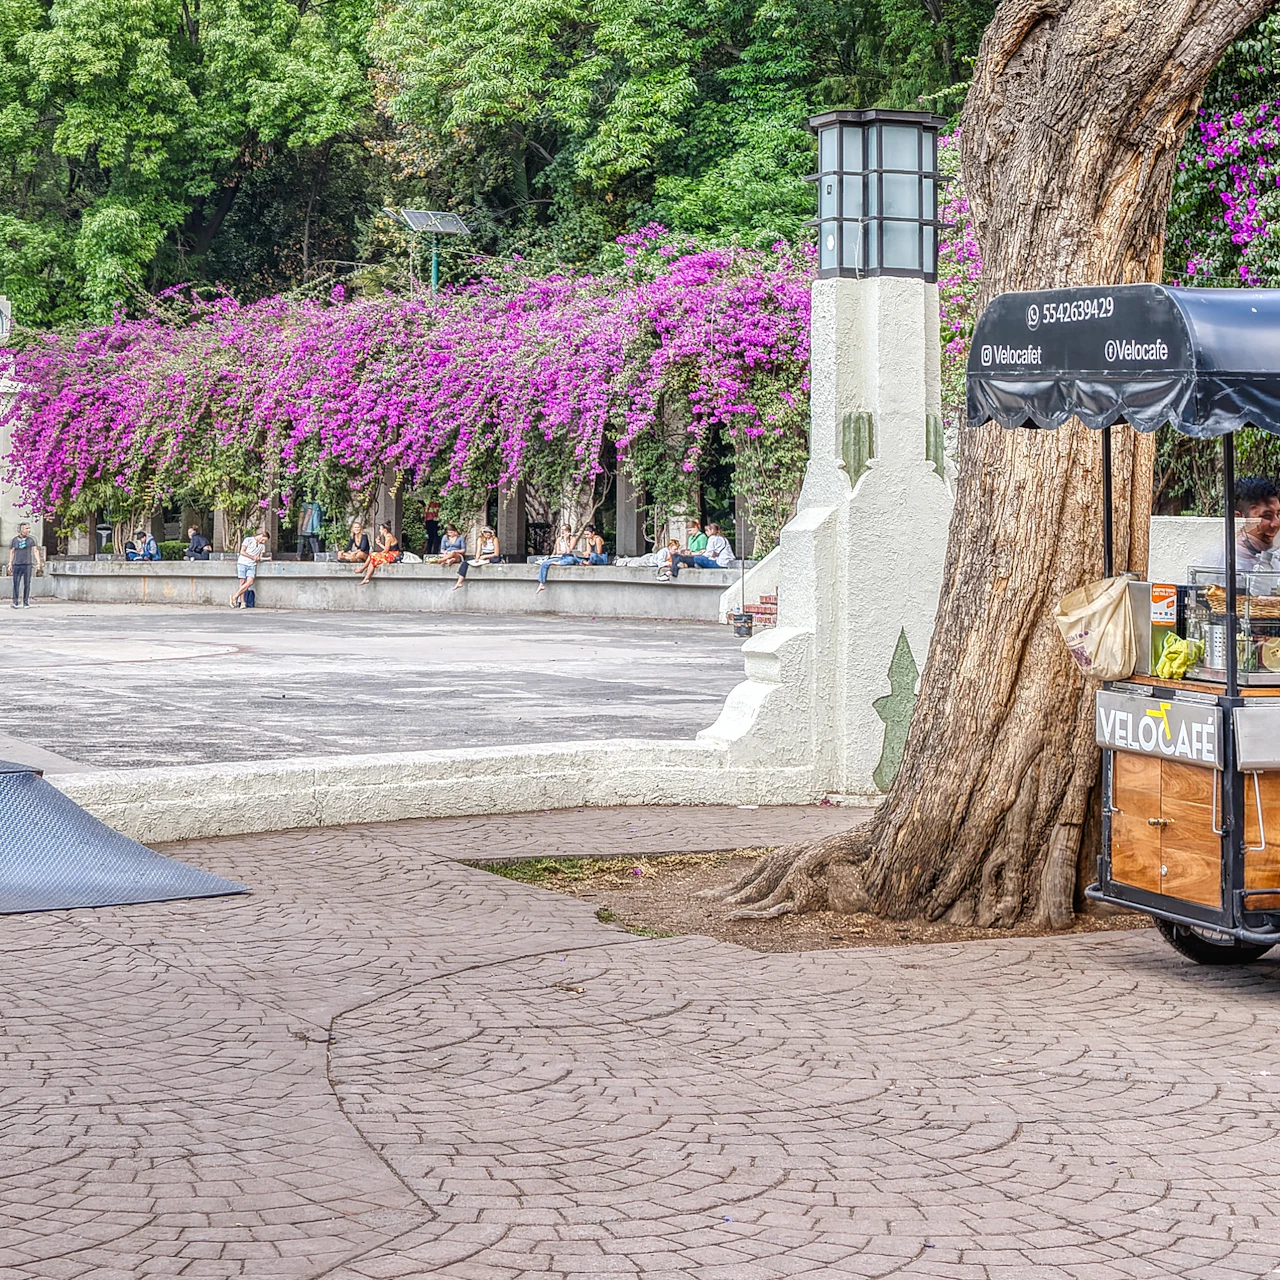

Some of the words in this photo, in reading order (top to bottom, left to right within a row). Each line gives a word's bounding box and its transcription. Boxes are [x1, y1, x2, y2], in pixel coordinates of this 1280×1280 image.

[1042, 296, 1114, 323] 5542639429
[993, 344, 1042, 365] Velocafet
[1115, 338, 1168, 360] Velocafe
[1099, 706, 1215, 762] VELOCAFÉ
